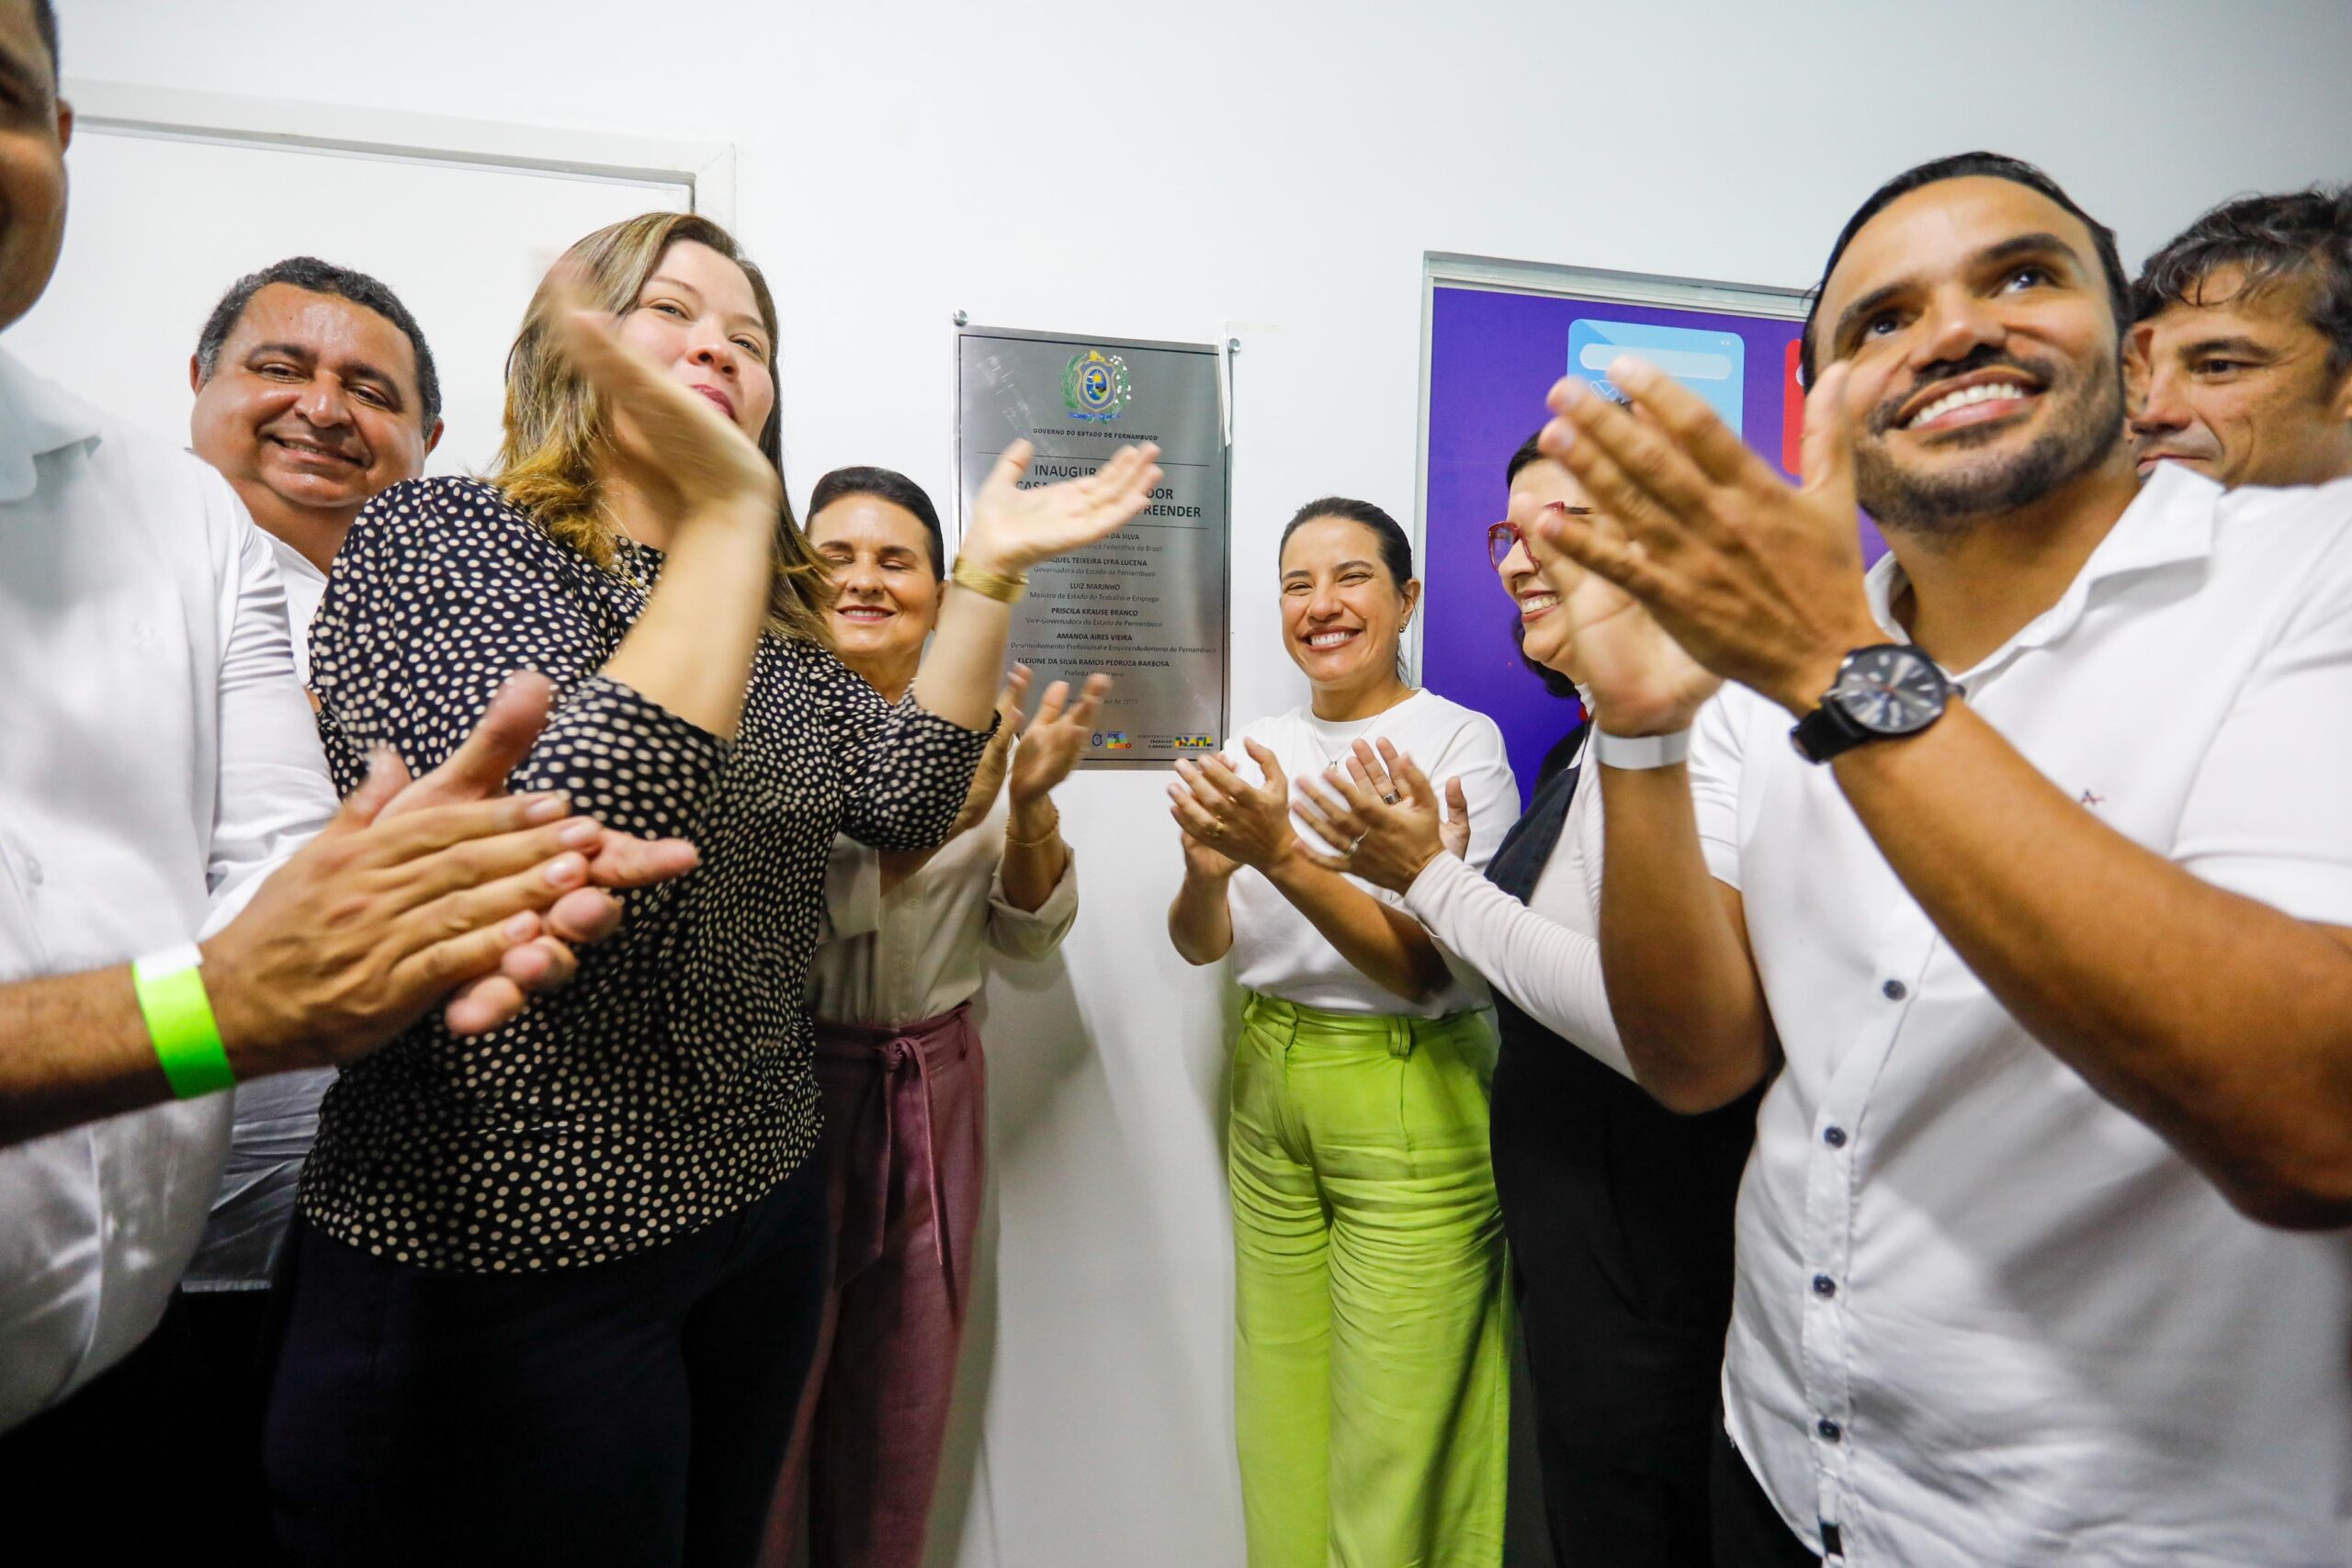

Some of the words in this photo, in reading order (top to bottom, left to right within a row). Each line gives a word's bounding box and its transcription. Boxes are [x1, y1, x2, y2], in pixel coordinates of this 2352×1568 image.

[1035, 465, 1097, 478] INAUGUR
[1147, 488, 1173, 500] DOR
[1143, 504, 1202, 517] REENDER
[1072, 557, 1102, 565] TEIXEIRA
[1124, 619, 1162, 627] Pernambuco
